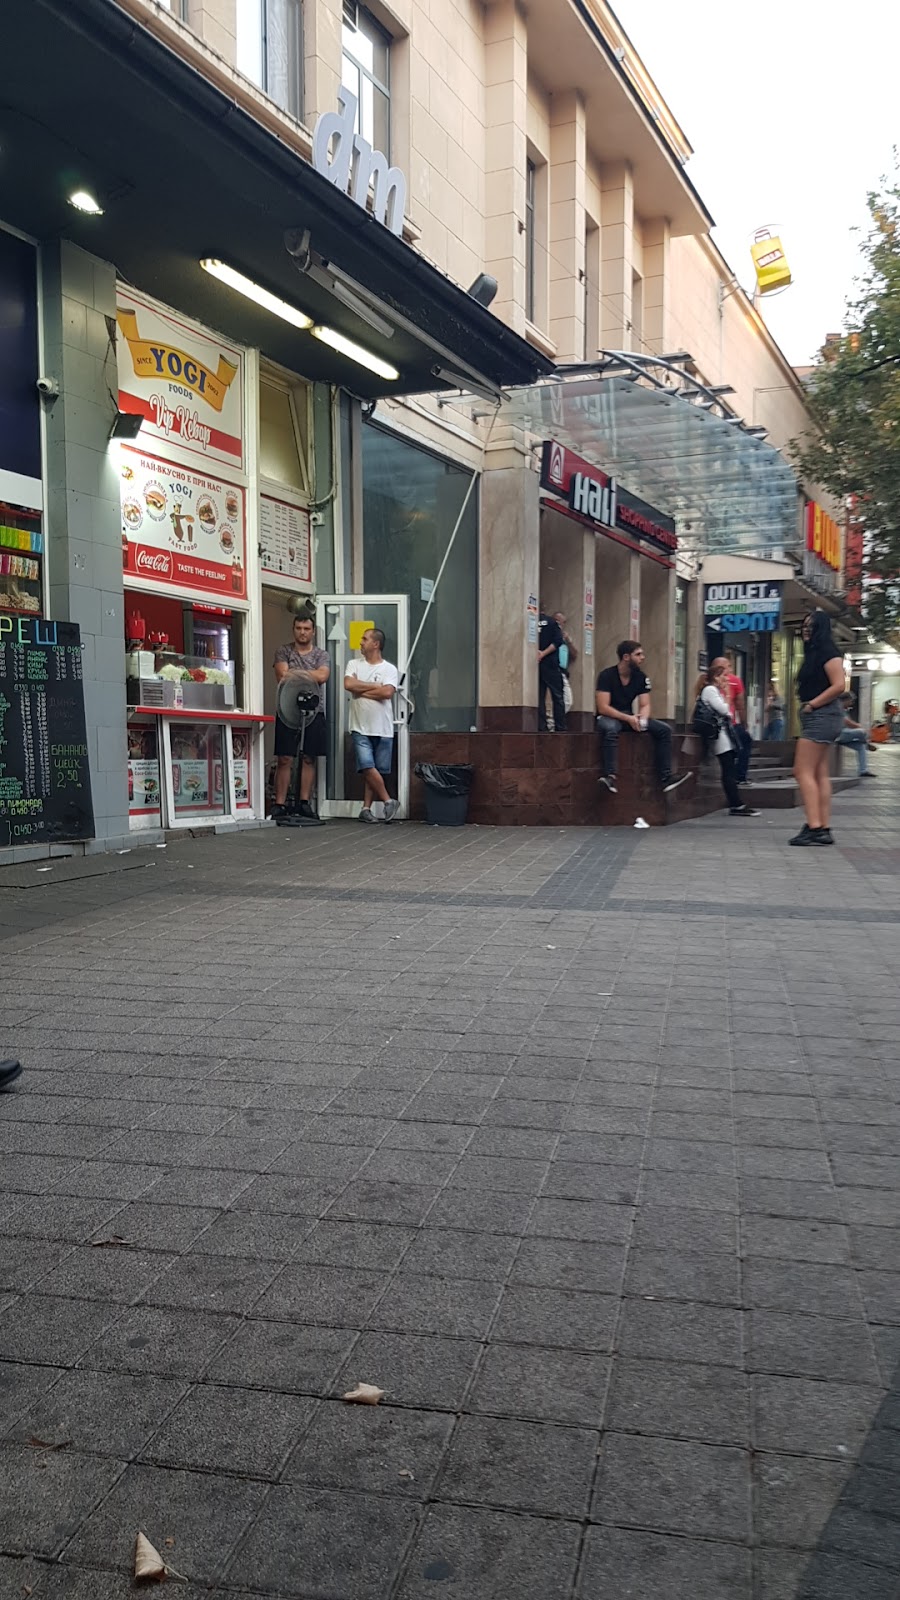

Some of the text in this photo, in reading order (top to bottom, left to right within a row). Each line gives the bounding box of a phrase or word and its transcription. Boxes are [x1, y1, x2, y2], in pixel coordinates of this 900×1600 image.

[312, 84, 407, 237] dm
[136, 357, 152, 365] SINCE
[150, 347, 207, 394] YOGI
[168, 382, 194, 401] FOODS
[149, 393, 176, 436] Vip
[169, 483, 193, 500] YOGI
[187, 474, 192, 483] Е
[192, 477, 206, 489] ПРИ
[207, 481, 222, 493] НАС!
[177, 563, 194, 574] TASTE
[194, 567, 205, 577] THE
[205, 569, 226, 581] FEELING
[707, 583, 779, 601] OUTLET &
[721, 612, 778, 632] SPOT
